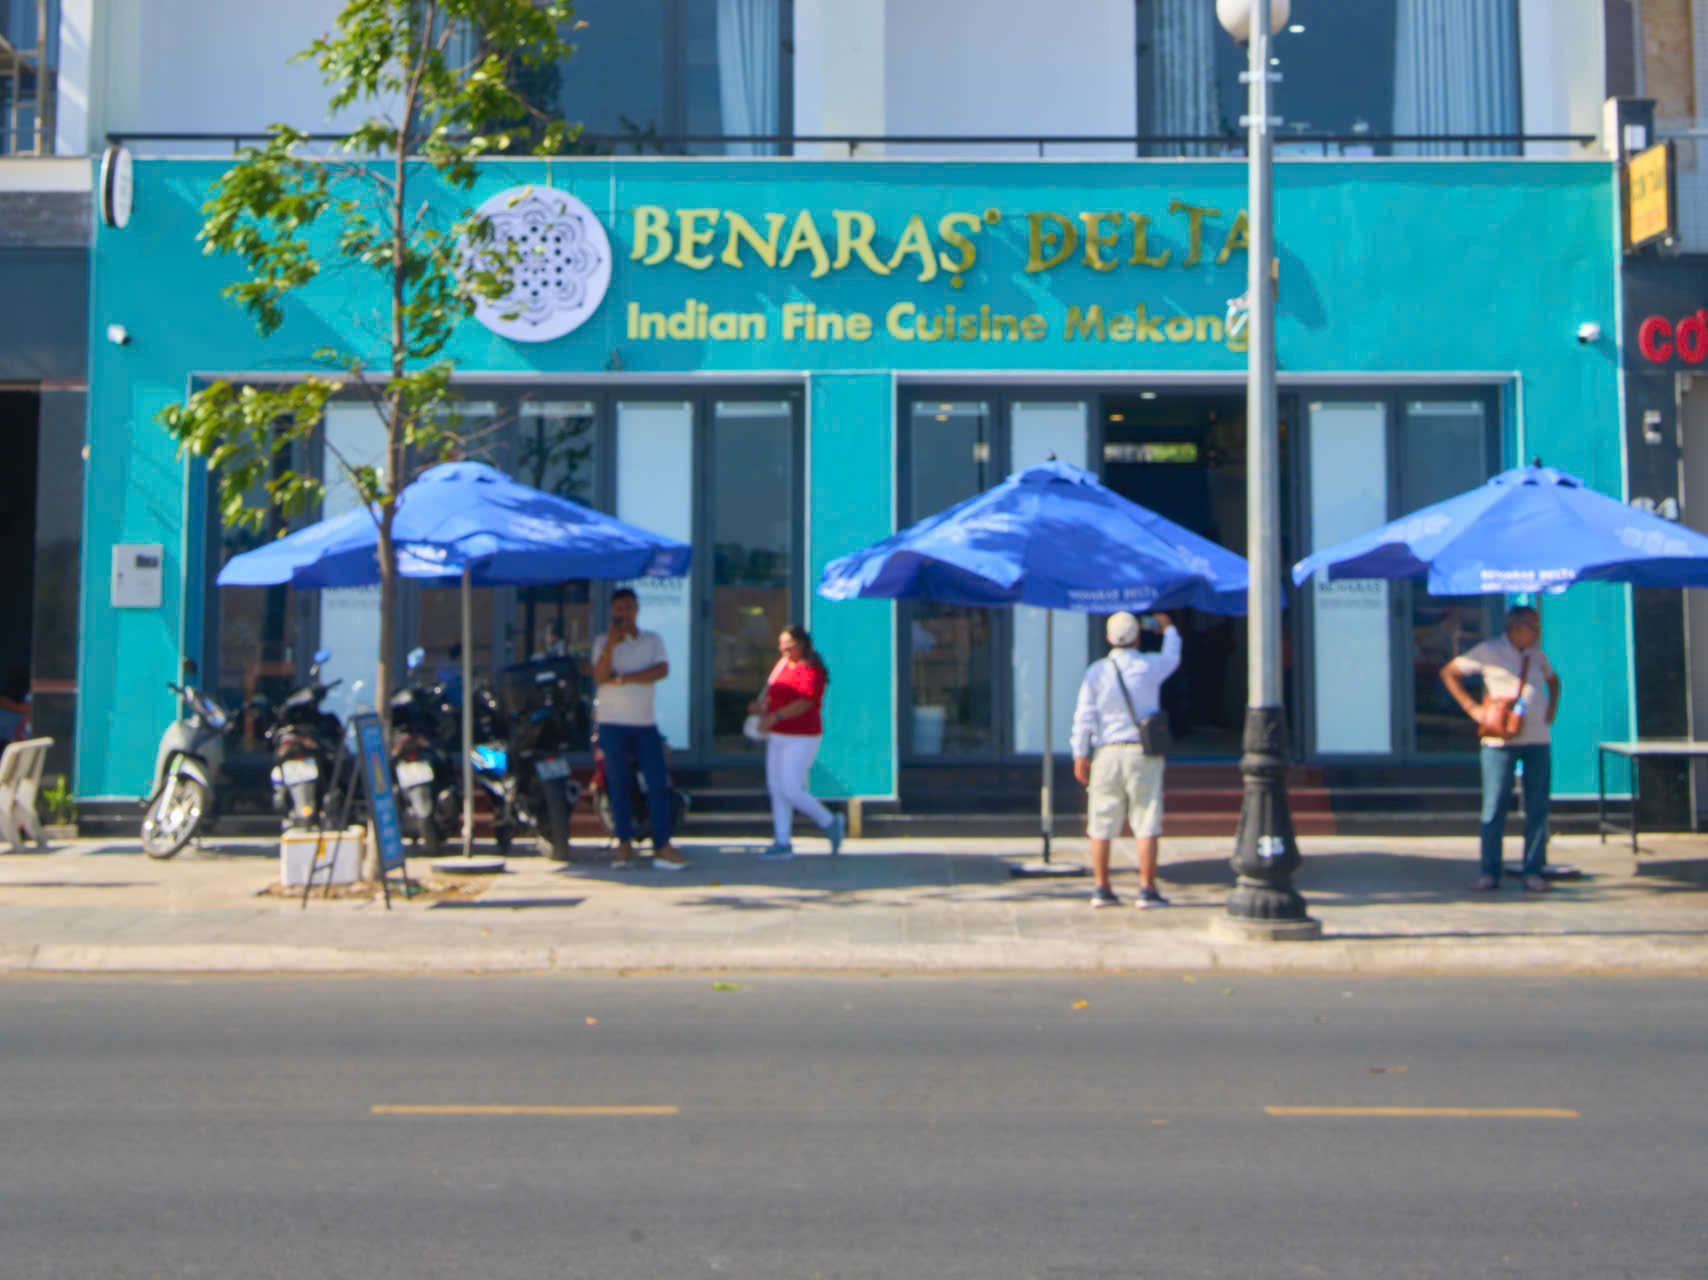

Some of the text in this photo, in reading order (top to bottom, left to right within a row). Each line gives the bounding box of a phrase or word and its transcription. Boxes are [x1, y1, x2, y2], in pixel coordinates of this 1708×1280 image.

[626, 298, 766, 342] Indian
[782, 302, 873, 342] Fine
[886, 301, 1048, 343] Cuisine
